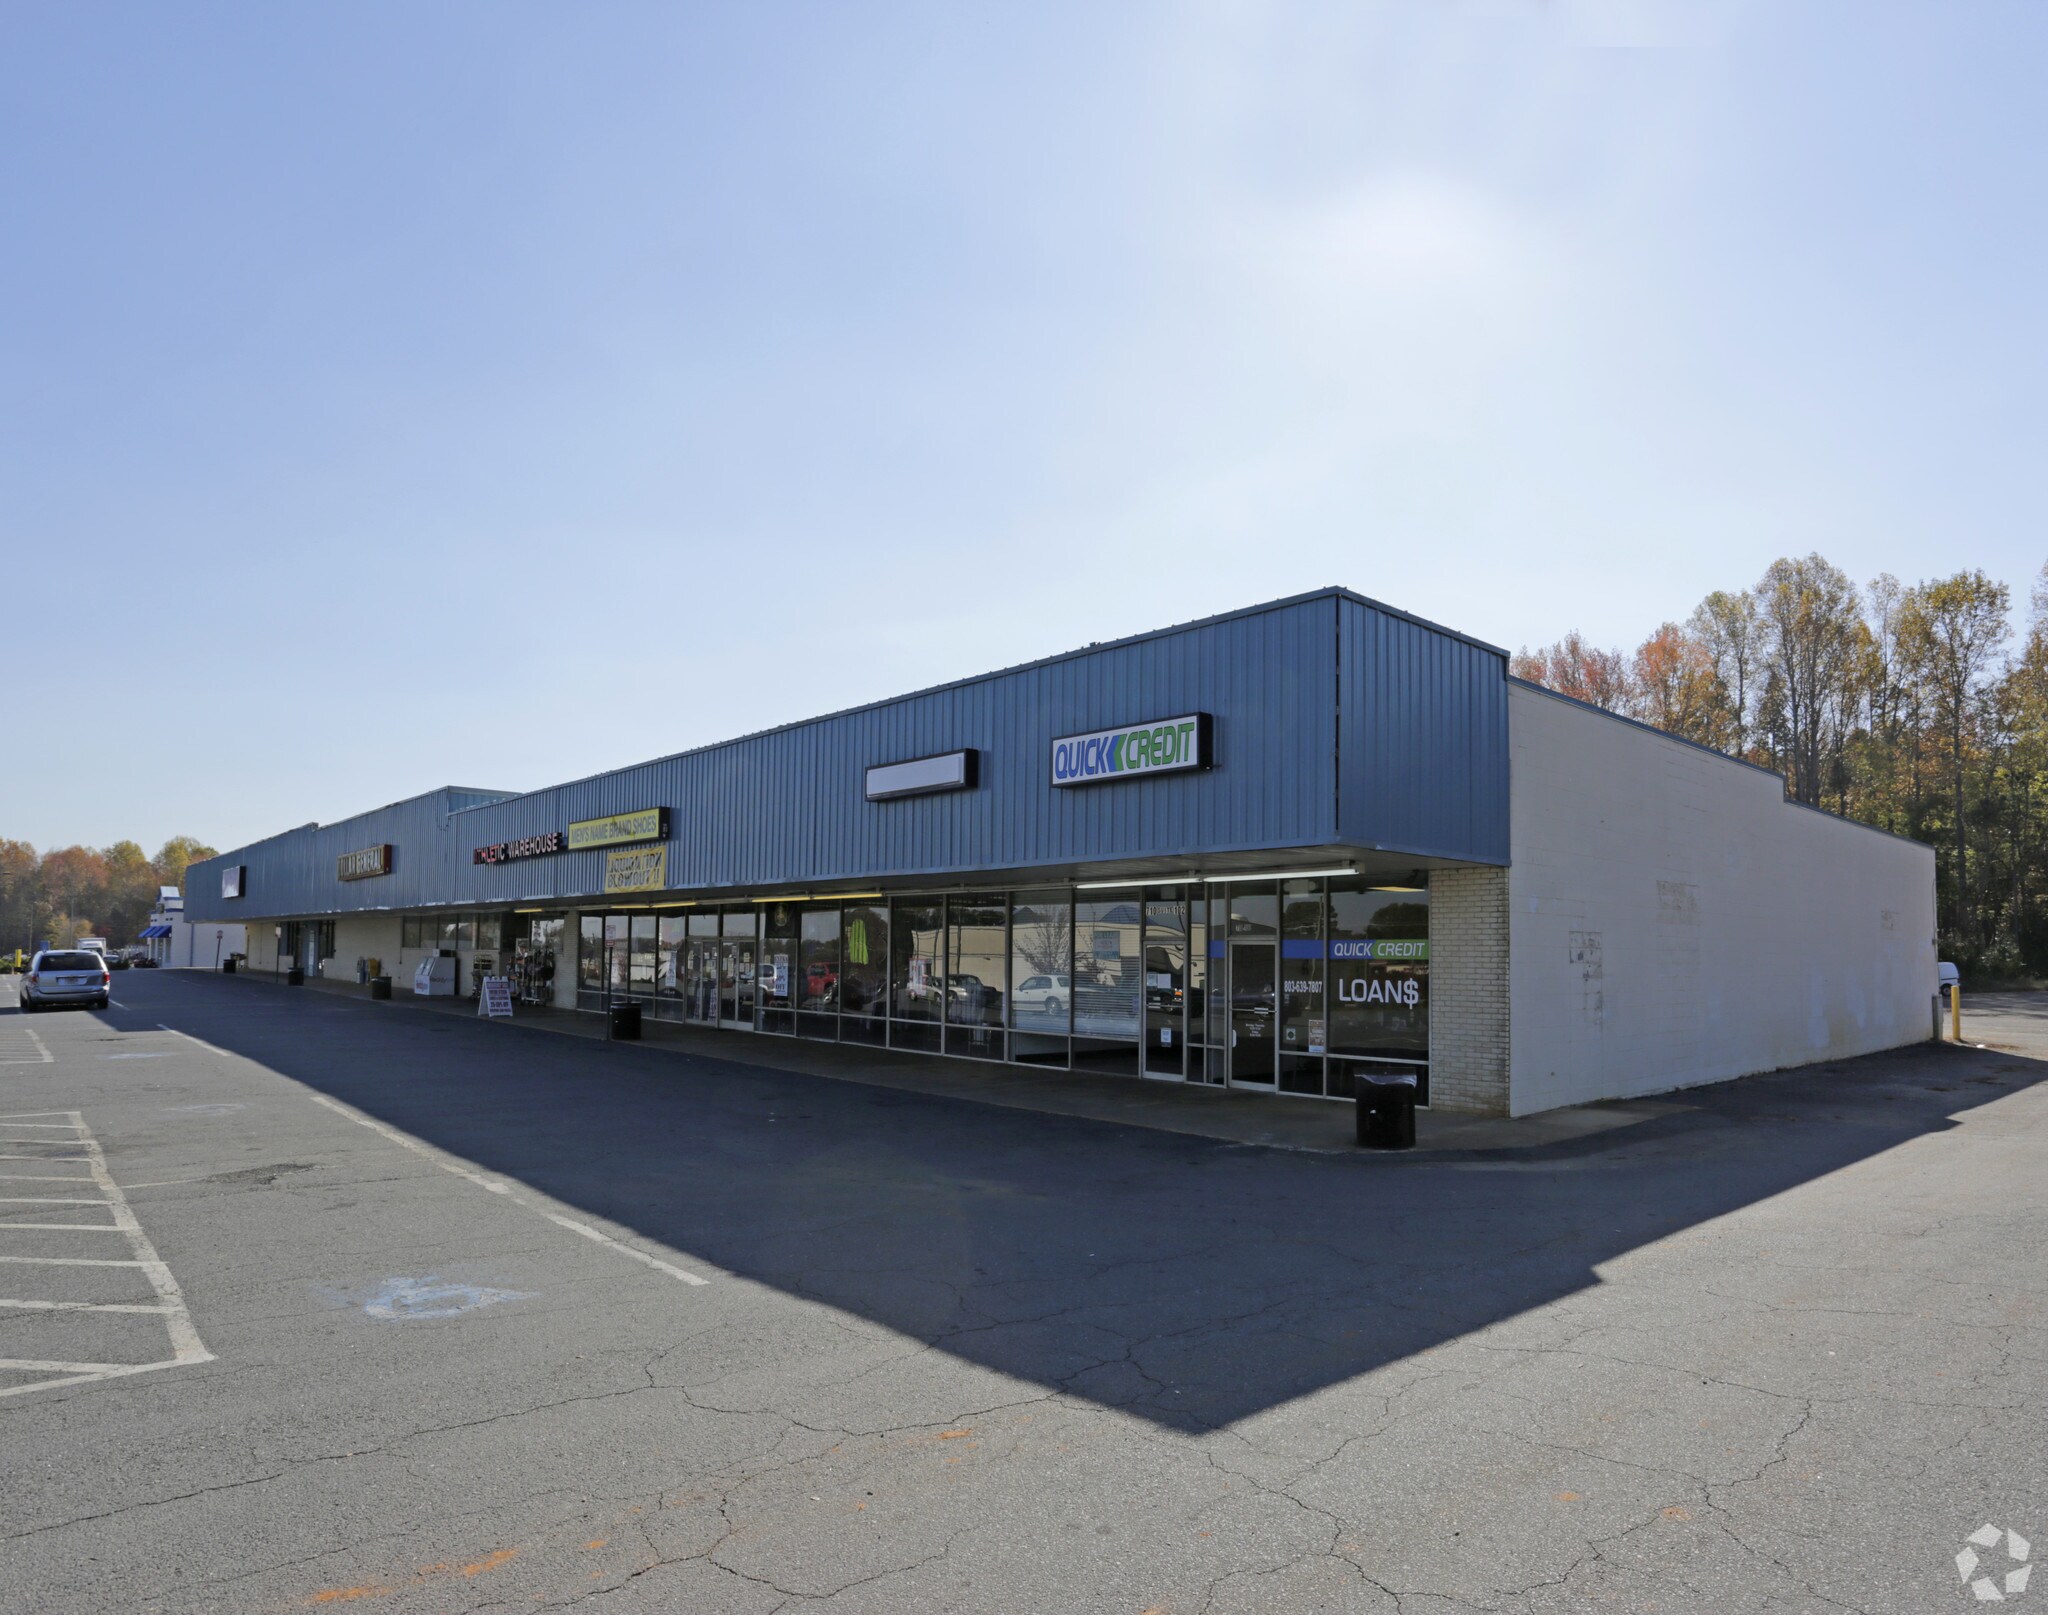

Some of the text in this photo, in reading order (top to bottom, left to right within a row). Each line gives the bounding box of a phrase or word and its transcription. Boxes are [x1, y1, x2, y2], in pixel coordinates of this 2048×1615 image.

[1055, 722, 1195, 779] QUICK CREDIT
[571, 815, 656, 843] MEN'S NAME BRAND SHOES
[507, 832, 558, 859] WAREHOUSE
[607, 870, 650, 888] BLOWOUT
[1334, 943, 1425, 956] QUICK CREDIT
[1284, 981, 1322, 993] 803-639-7807
[1339, 978, 1419, 1010] LOAN$
